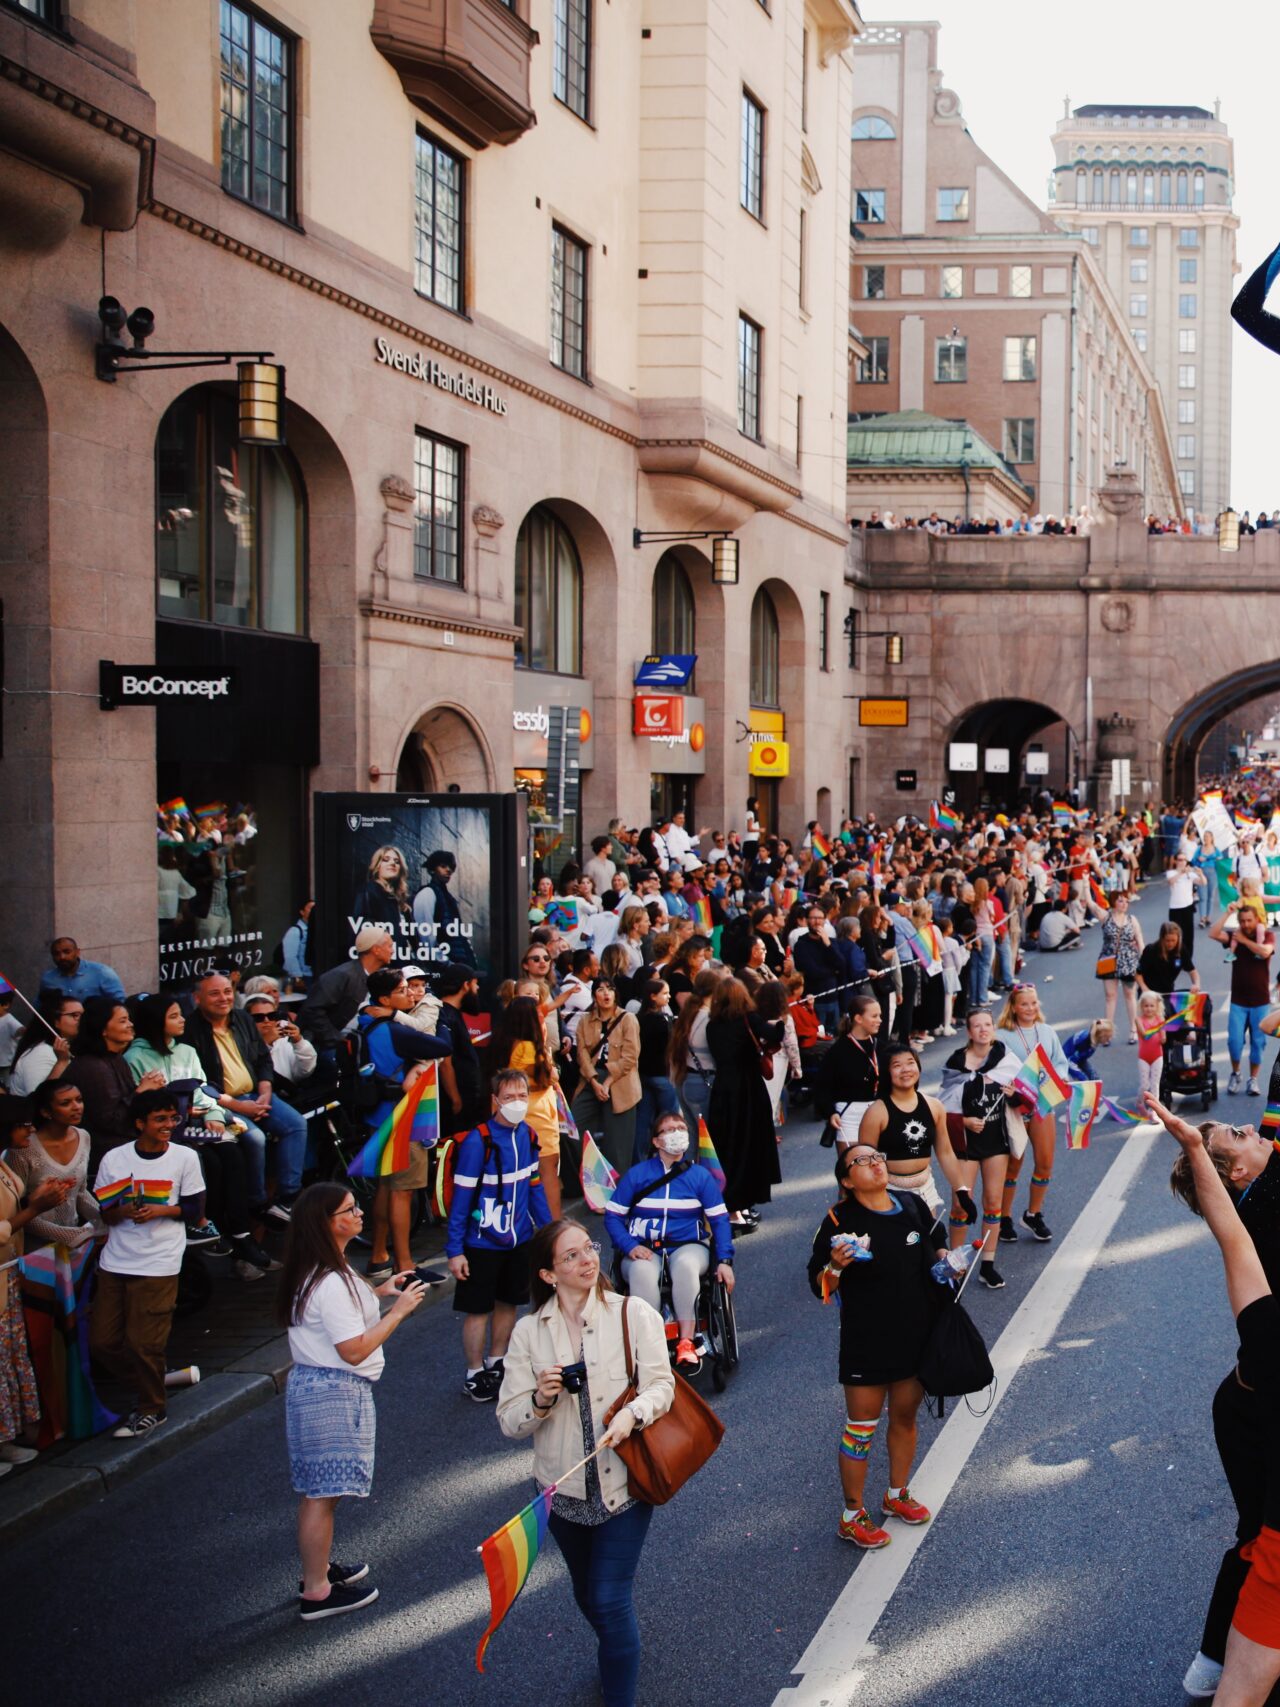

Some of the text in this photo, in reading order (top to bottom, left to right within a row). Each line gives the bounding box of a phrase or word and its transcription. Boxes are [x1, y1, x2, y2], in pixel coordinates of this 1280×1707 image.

[375, 336, 508, 416] Svensk Handels Hus
[122, 676, 229, 699] BoConcept
[399, 919, 441, 937] tror
[446, 917, 473, 937] du
[416, 942, 451, 962] är?
